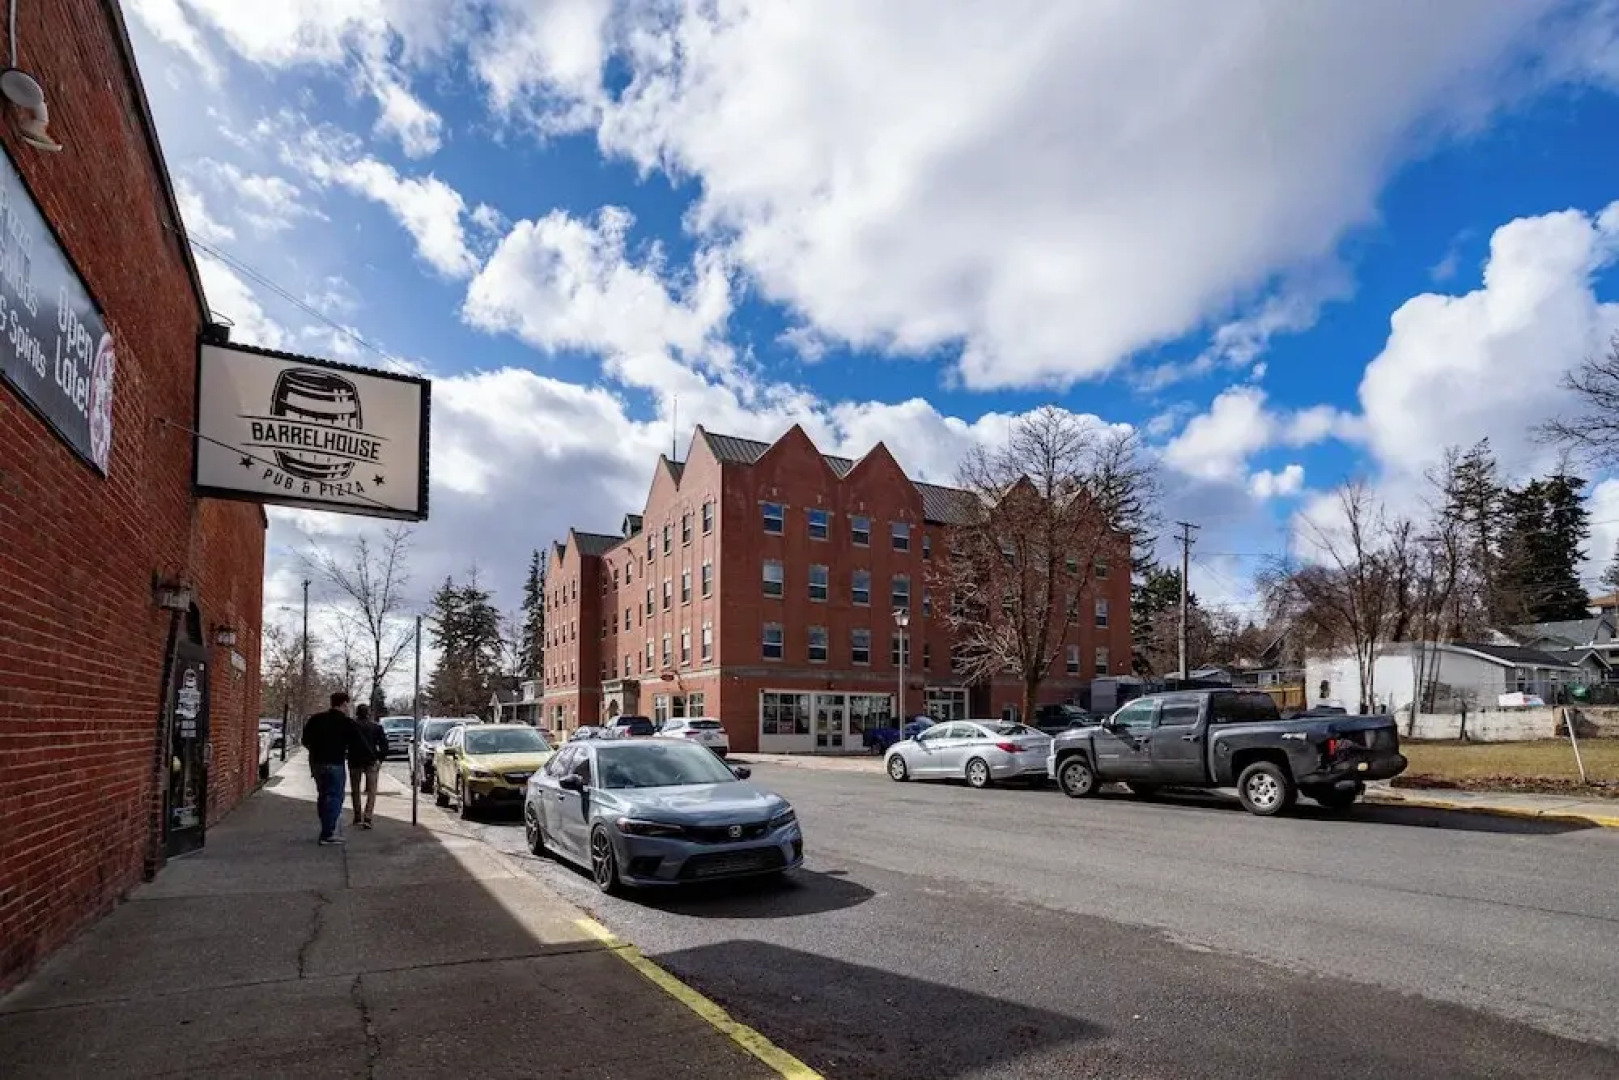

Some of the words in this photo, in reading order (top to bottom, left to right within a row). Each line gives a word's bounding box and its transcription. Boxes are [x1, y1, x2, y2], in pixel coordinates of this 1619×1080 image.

[10, 310, 46, 379] Spirits
[58, 286, 93, 372] Open
[55, 334, 91, 419] Late!
[251, 422, 381, 461] BARRELHOUSE
[262, 469, 294, 489] PUB
[319, 481, 365, 497] PIZZA
